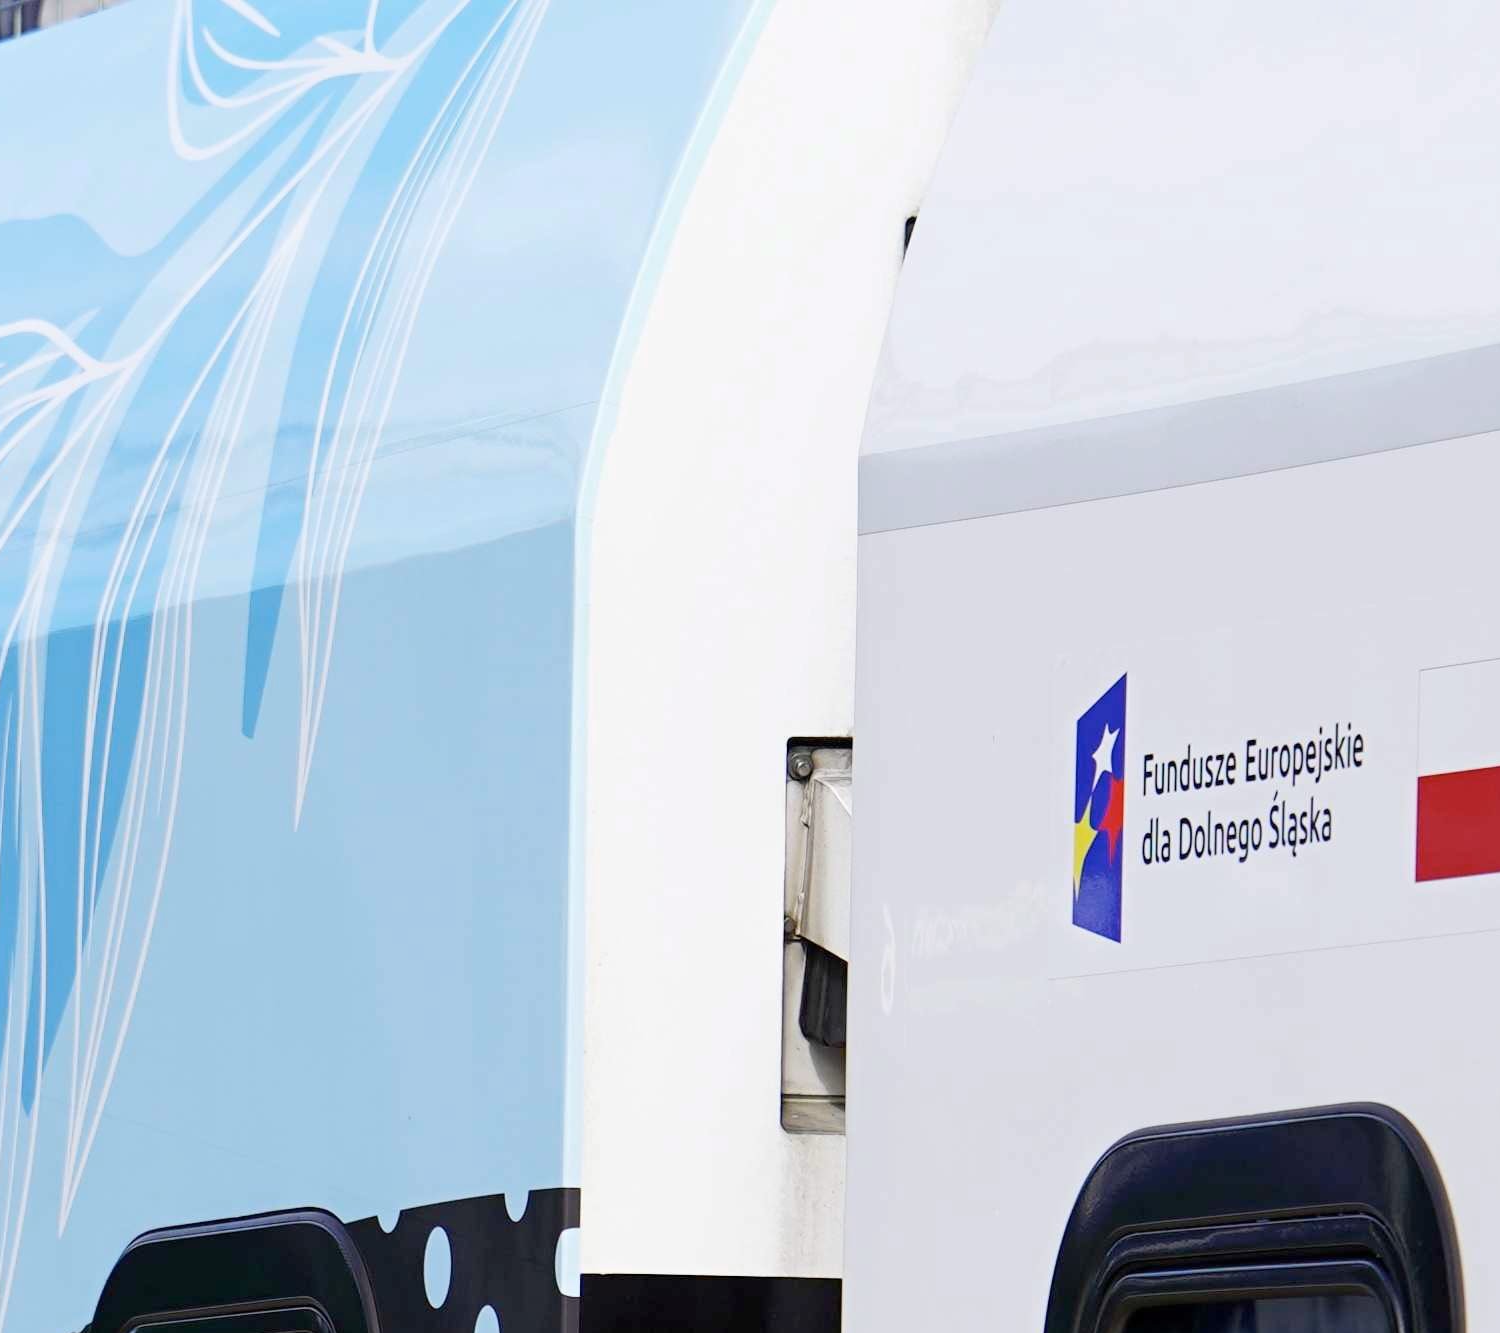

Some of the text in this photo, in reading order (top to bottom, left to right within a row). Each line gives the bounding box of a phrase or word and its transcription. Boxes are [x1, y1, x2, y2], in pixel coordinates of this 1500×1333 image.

[1142, 721, 1366, 797] Fundusze Europejskie
[1141, 790, 1333, 866] dla Dolnego Śląska
